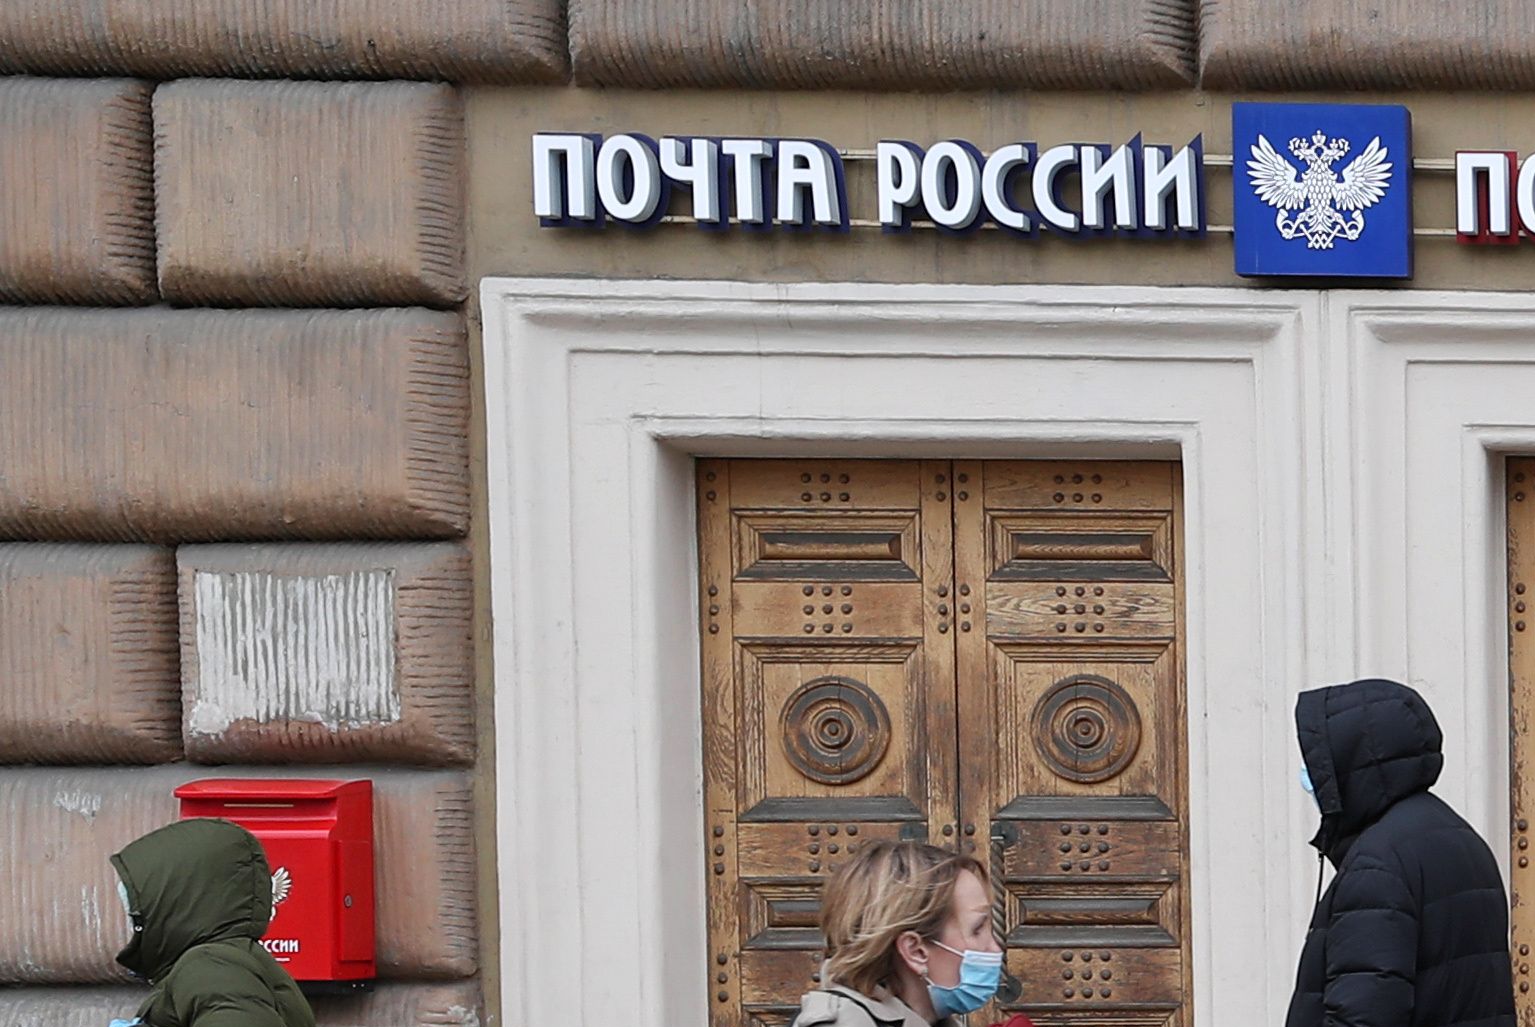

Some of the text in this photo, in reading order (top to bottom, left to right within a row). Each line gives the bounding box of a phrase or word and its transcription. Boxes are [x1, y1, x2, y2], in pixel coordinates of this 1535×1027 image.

[532, 132, 1204, 235] ПОЧТА РОССИИ
[258, 939, 299, 953] ССИИ
